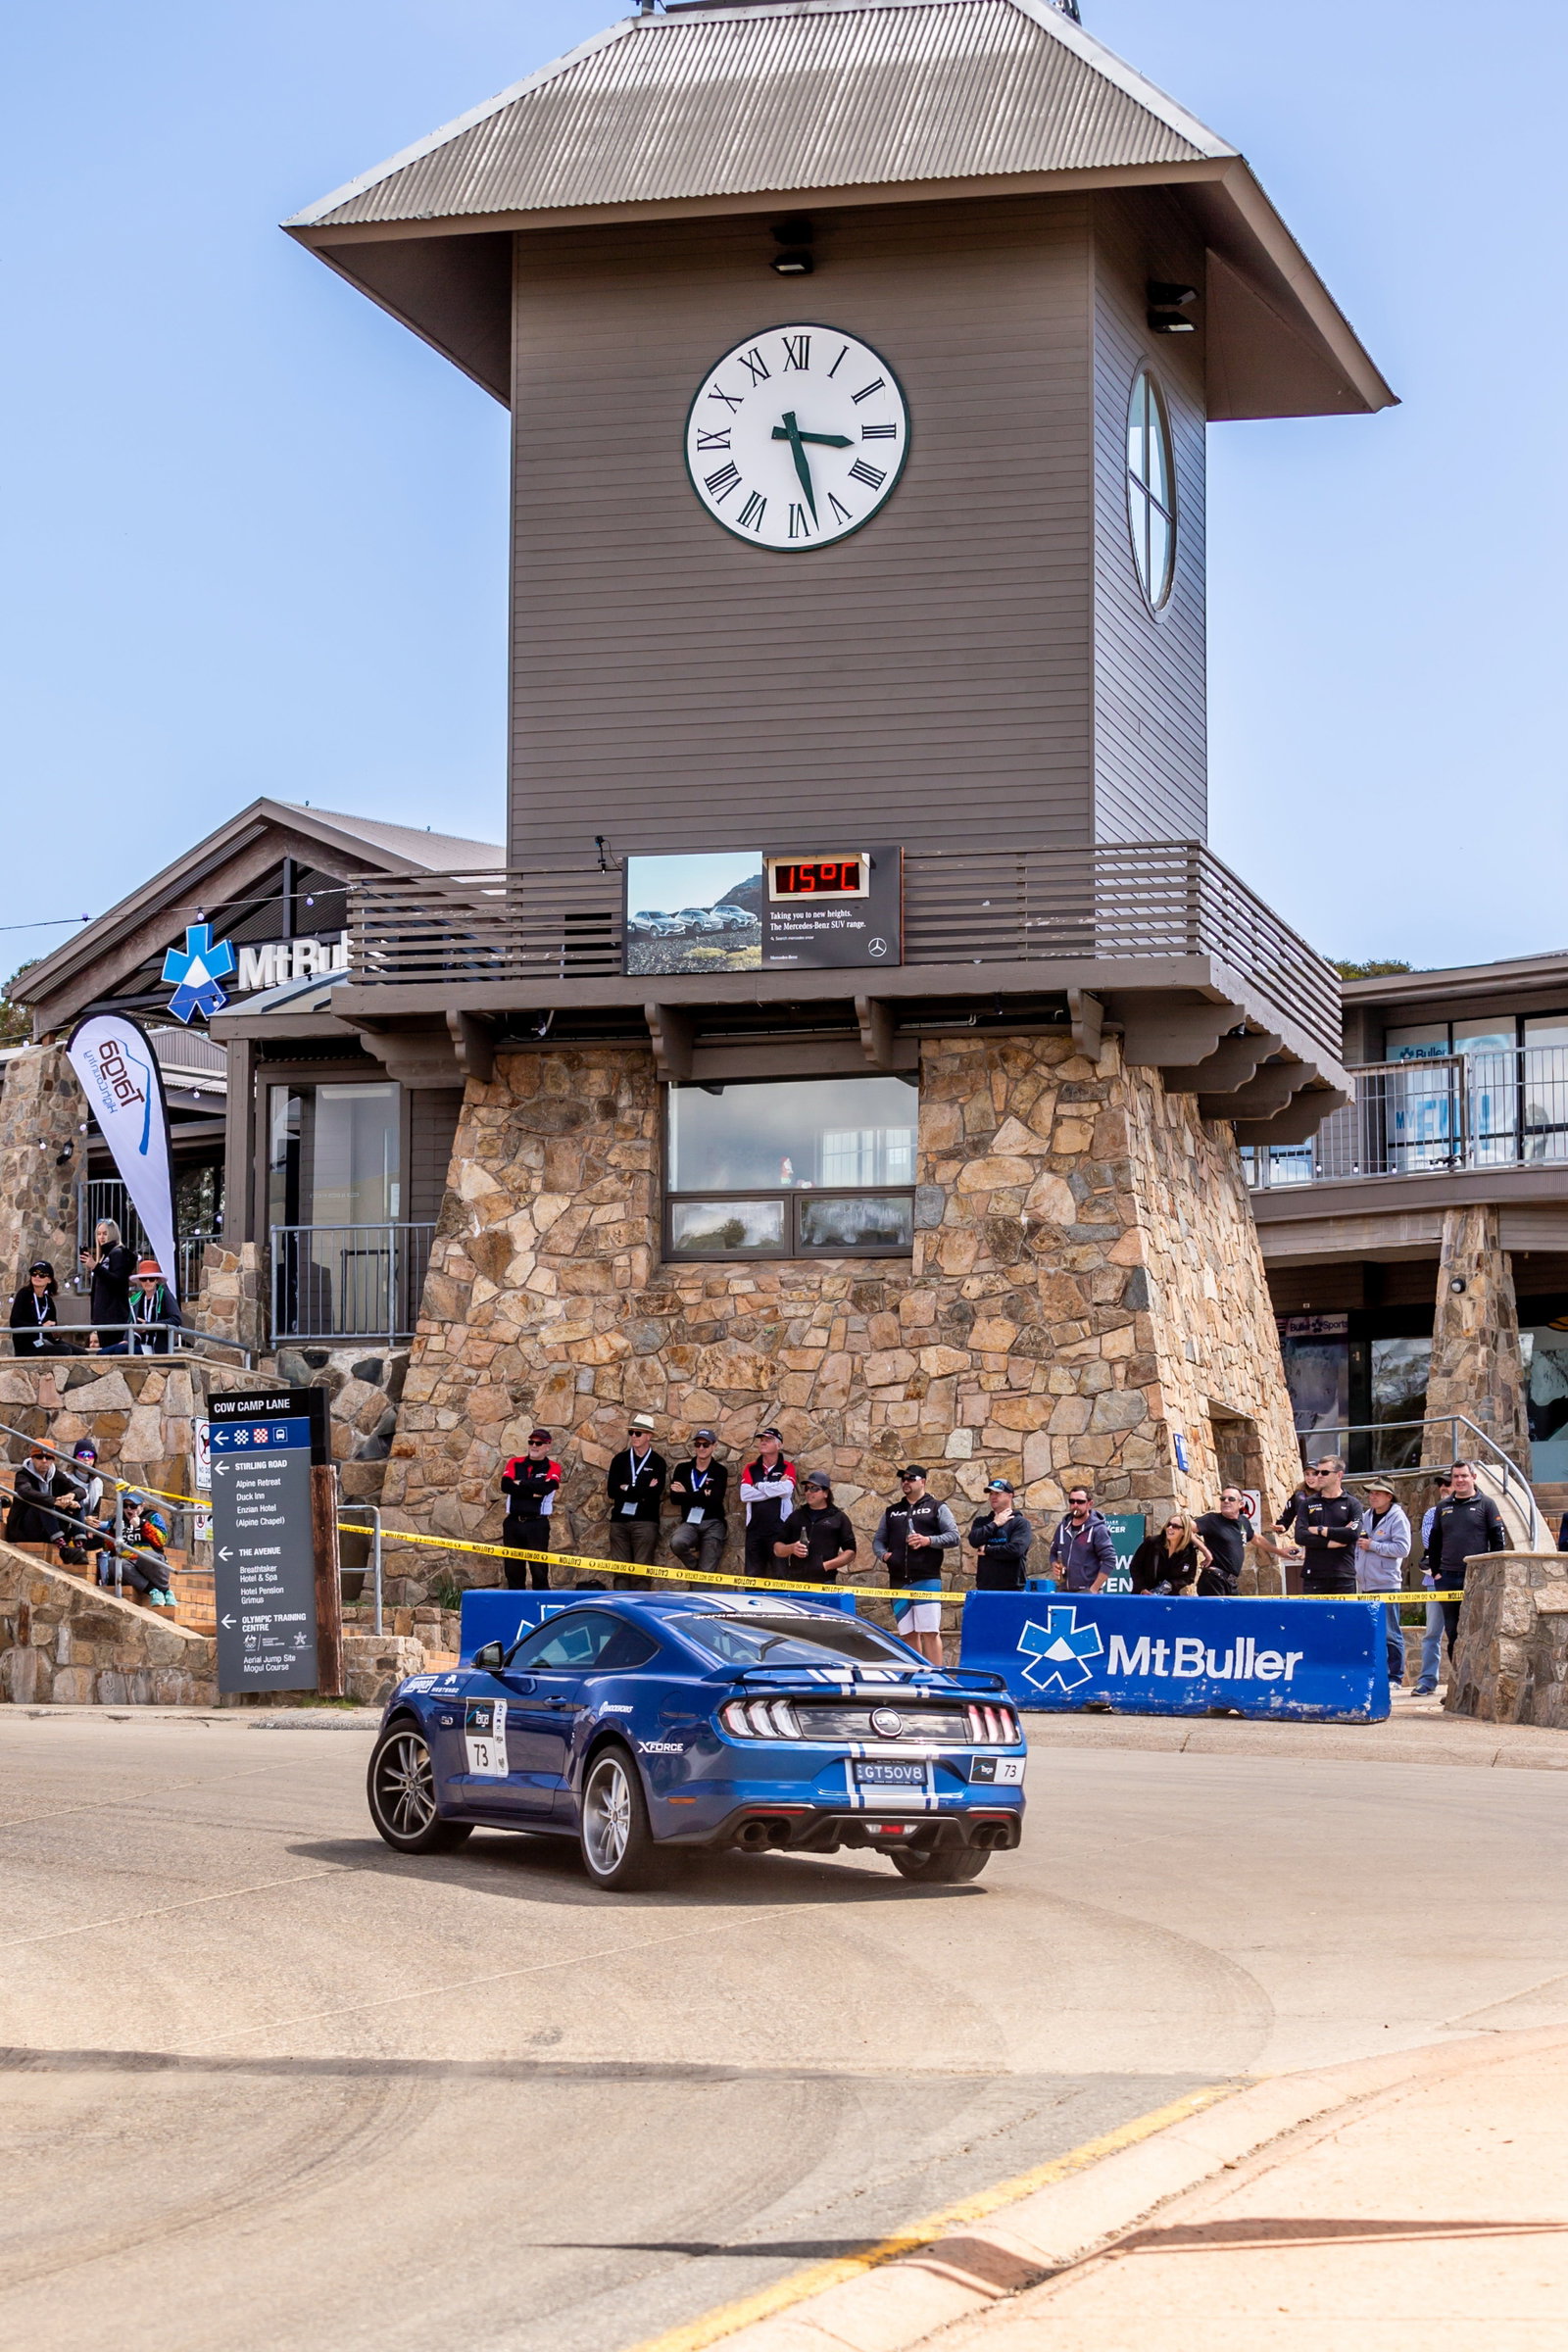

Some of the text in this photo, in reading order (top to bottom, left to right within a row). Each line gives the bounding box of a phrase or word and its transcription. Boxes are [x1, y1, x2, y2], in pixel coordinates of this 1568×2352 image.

[781, 335, 811, 372] XII
[737, 347, 771, 387] XI
[827, 345, 850, 378] I
[851, 376, 886, 405] II
[708, 383, 744, 414] X
[861, 422, 897, 441] III
[697, 427, 732, 452] IX
[848, 458, 887, 491] IIII
[704, 460, 743, 505] VIII
[736, 490, 767, 533] VII
[827, 492, 853, 525] V
[788, 504, 811, 538] VI
[770, 911, 791, 920] Taking
[827, 909, 852, 919] heights.
[783, 921, 830, 931] Mercedes-Benz
[831, 920, 845, 929] SUV
[846, 921, 866, 930] range.
[1323, 1320, 1348, 1331] Sports
[214, 1398, 291, 1413] COW CAMP LANE
[235, 1460, 288, 1471] STIRLING ROAD
[236, 1478, 281, 1489] Alpine Retreat
[236, 1493, 254, 1501] Duck
[260, 1504, 277, 1512] Hotel
[236, 1516, 285, 1528] (Alpine Chapel)
[239, 1546, 281, 1557] THE AVENUE
[472, 1544, 494, 1554] CAUTION
[559, 1556, 581, 1566] CAUTION
[240, 1565, 277, 1574] Breathtaker
[646, 1568, 669, 1577] CAUTION
[240, 1574, 257, 1583] Hotel
[265, 1573, 278, 1582] Spa
[734, 1578, 756, 1586] CAUTION
[241, 1586, 284, 1596] Hotel Pension
[241, 1596, 264, 1605] Grimus
[242, 1613, 306, 1624] OLYMPIC TRAINING
[242, 1624, 269, 1632] CENTRE
[244, 1664, 264, 1673] Mogul
[637, 1741, 684, 1753] XFORCE
[473, 1744, 489, 1767] 73
[1004, 1765, 1017, 1777] 73
